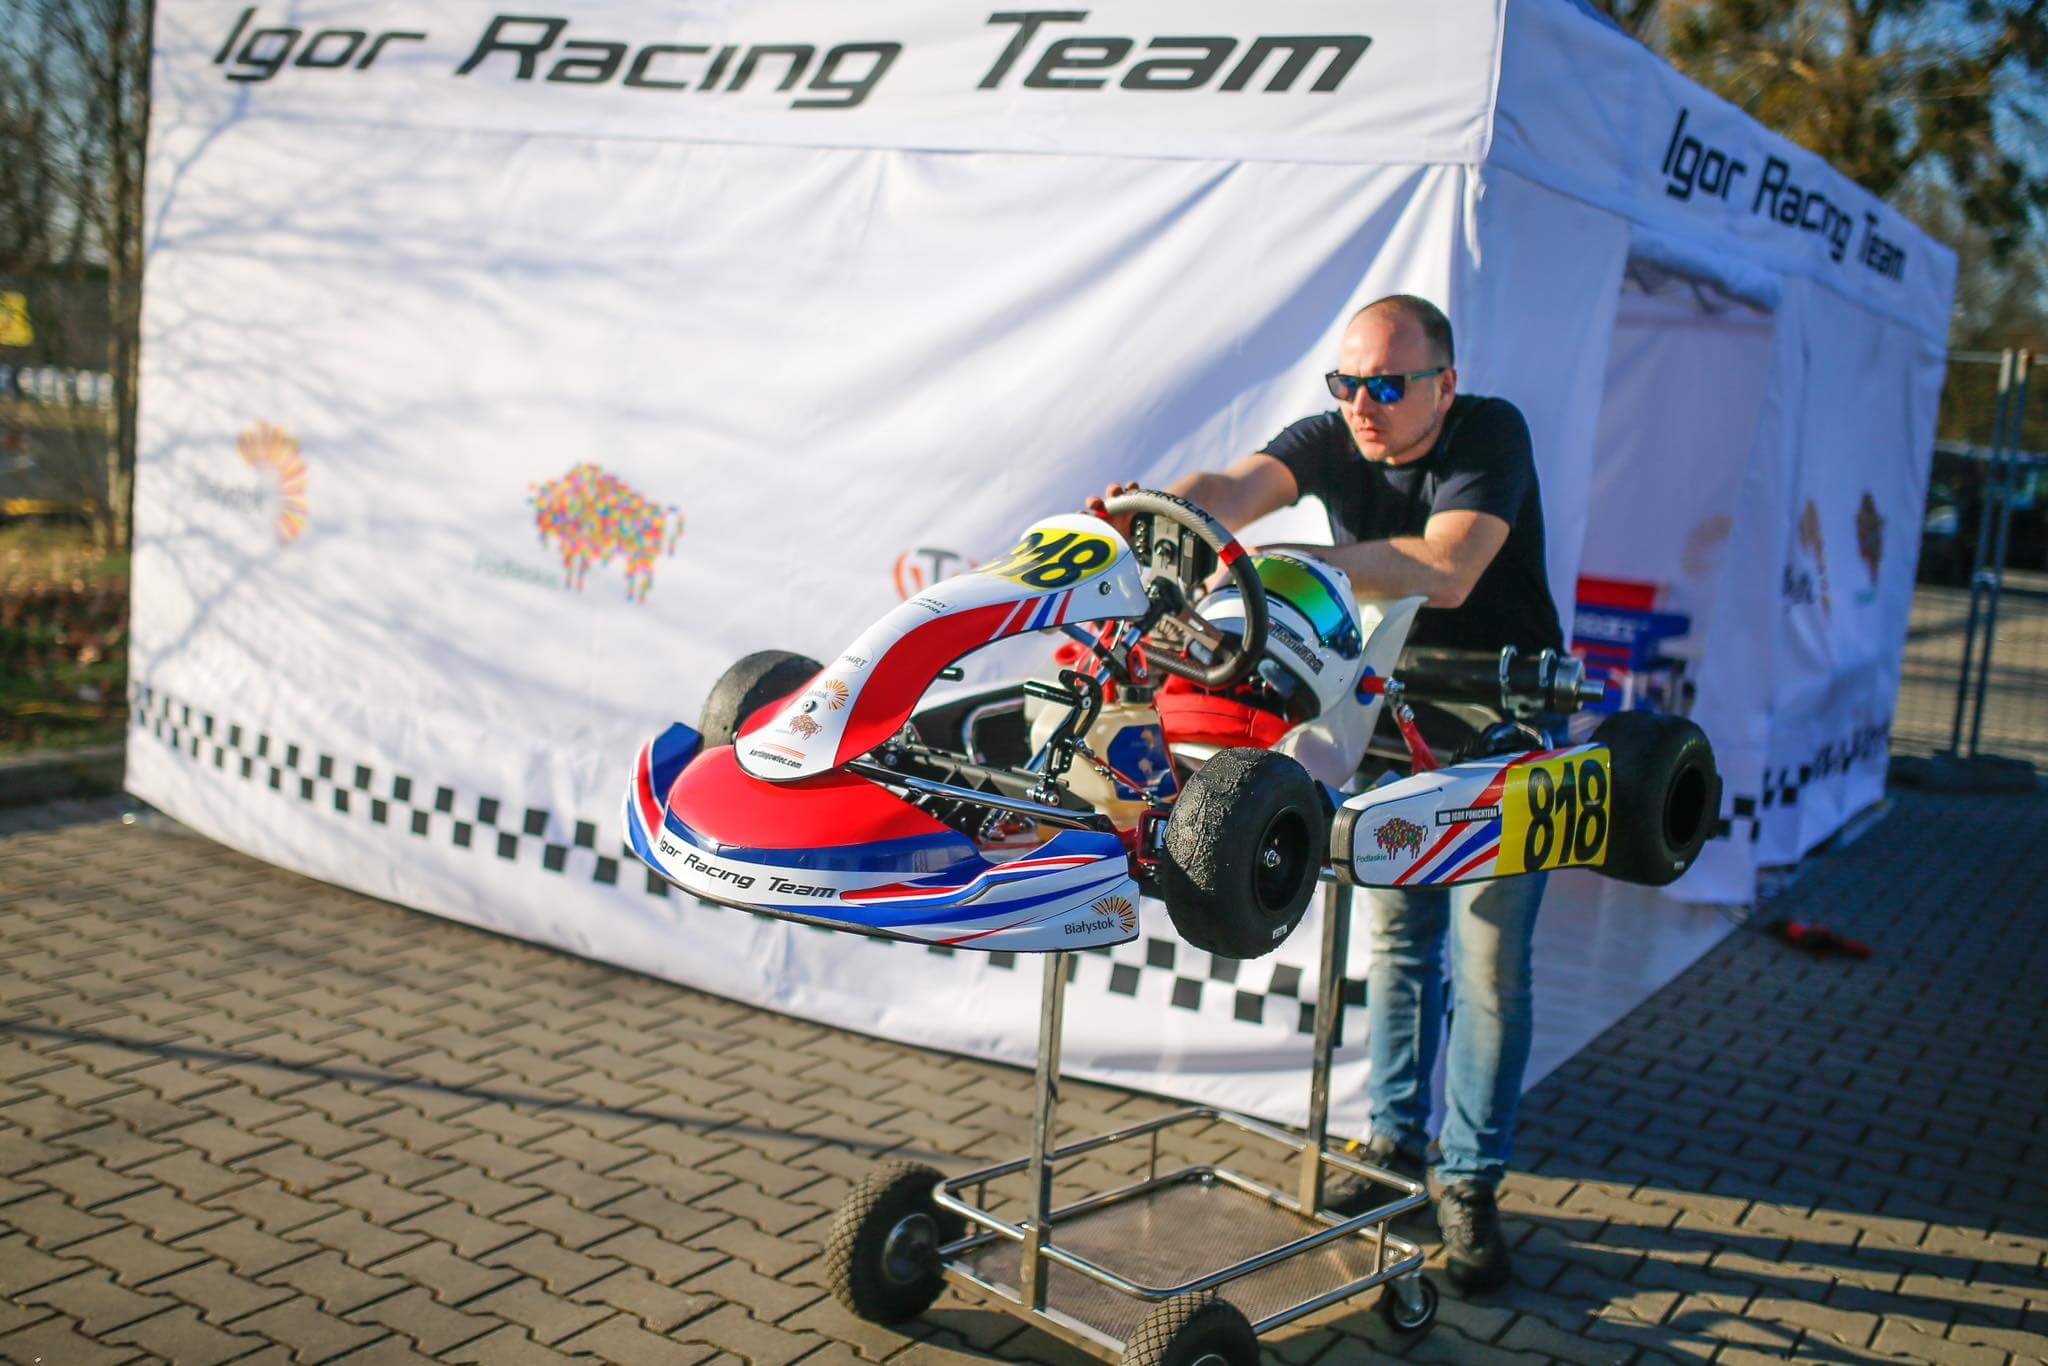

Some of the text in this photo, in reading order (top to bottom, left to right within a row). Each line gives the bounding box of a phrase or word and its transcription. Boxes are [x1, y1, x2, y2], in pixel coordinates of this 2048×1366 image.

[214, 7, 1373, 110] Igor Racing Team
[1662, 107, 1747, 200] Igor
[1859, 210, 1907, 282] Team
[1523, 757, 1608, 872] 818
[659, 835, 838, 898] Igor Racing Team
[1064, 916, 1115, 935] Białystok
